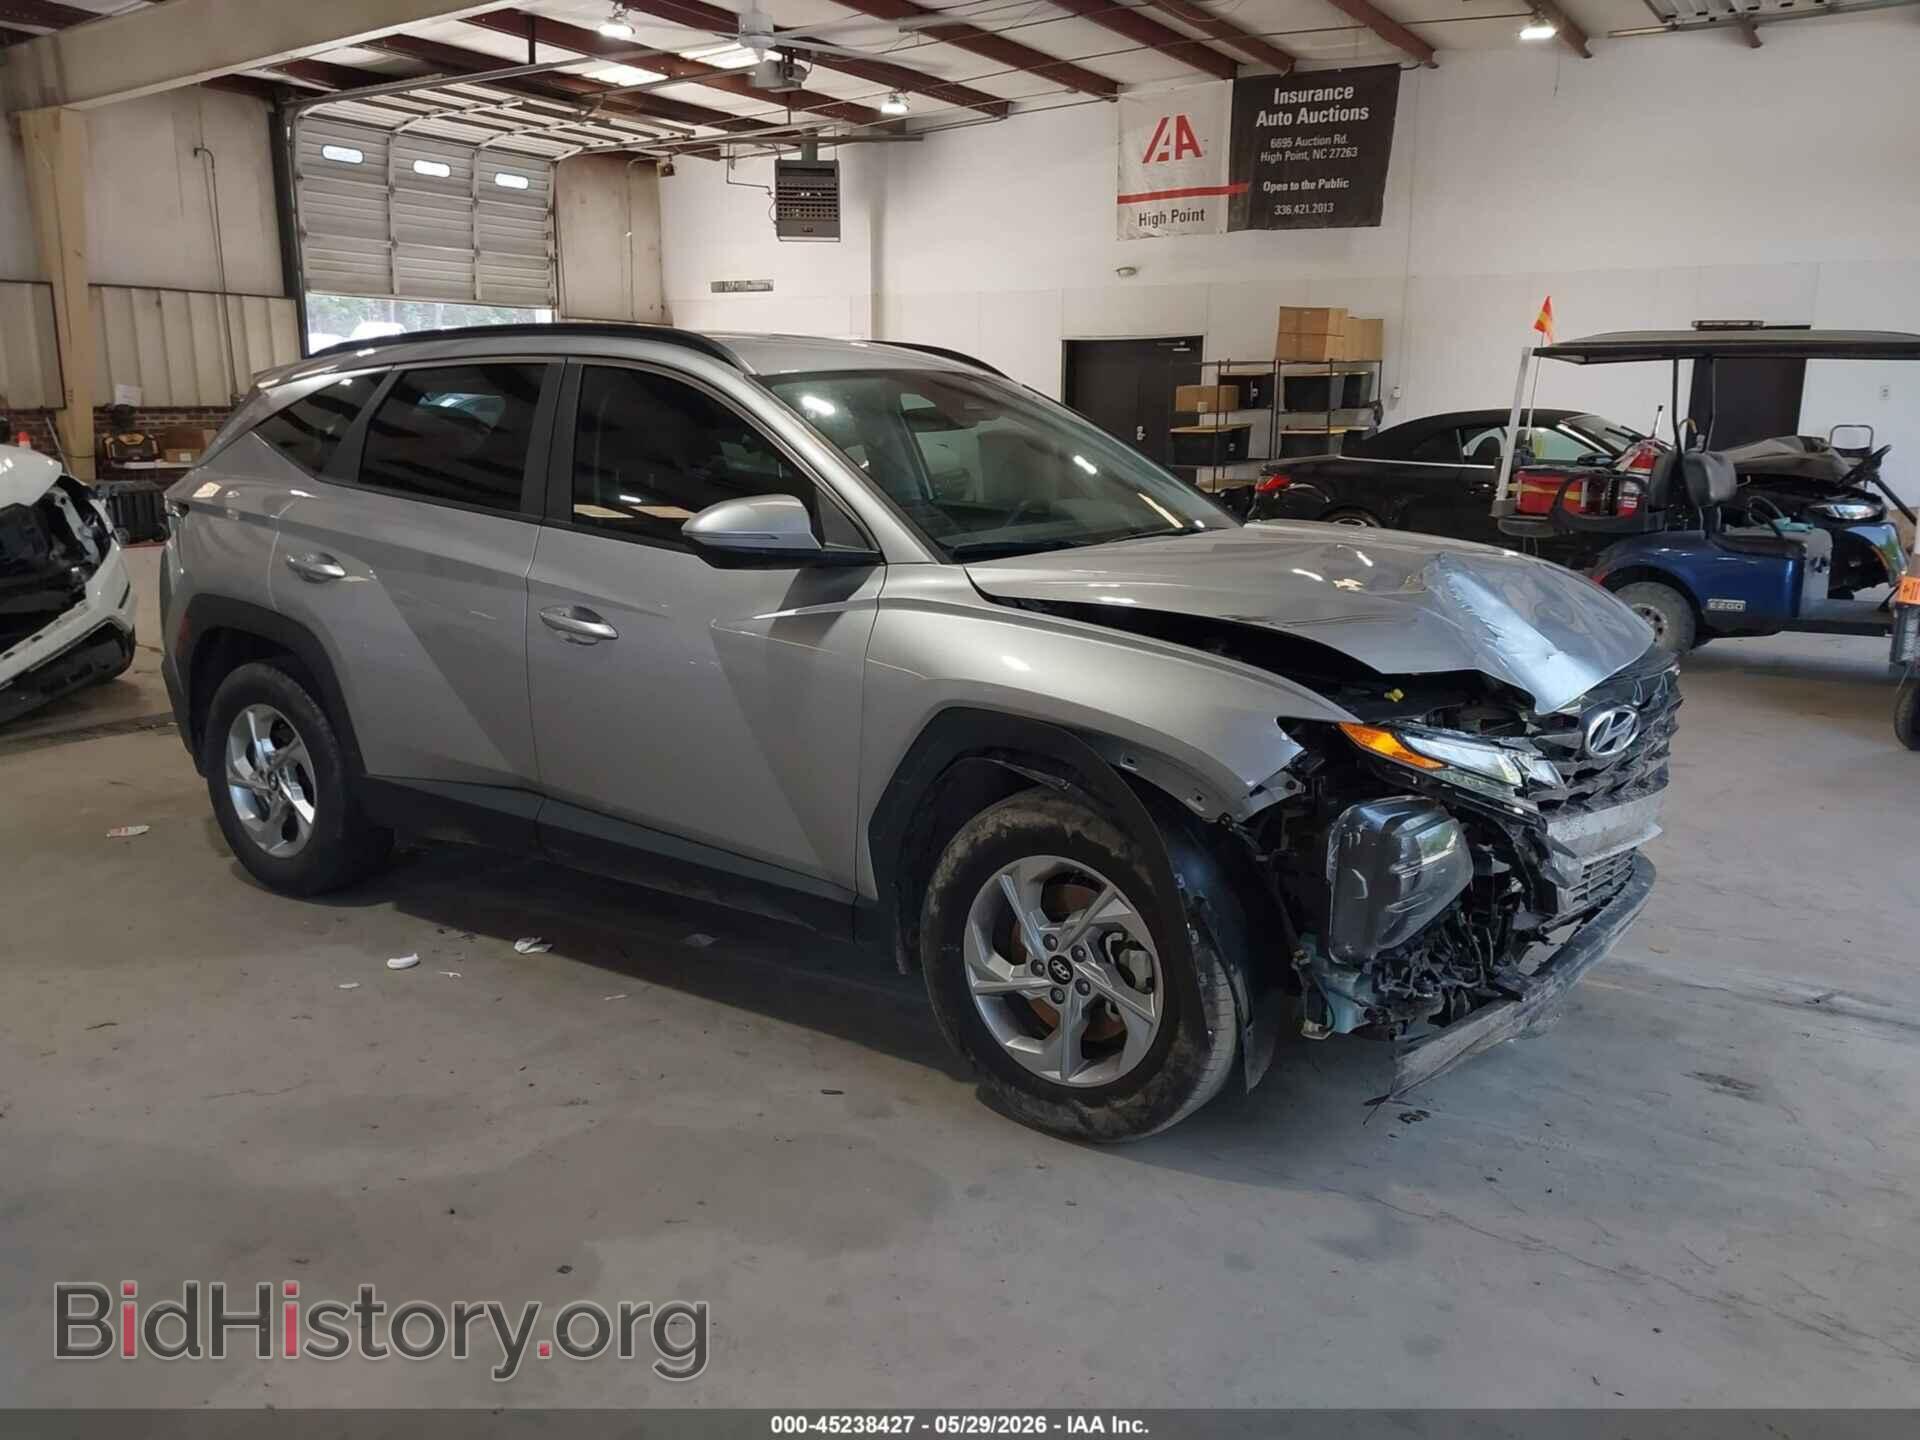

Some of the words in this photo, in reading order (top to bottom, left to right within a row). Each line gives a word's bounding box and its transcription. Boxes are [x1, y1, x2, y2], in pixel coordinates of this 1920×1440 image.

[1274, 86, 1354, 105] Insurance
[1256, 108, 1293, 128] Auto
[1296, 104, 1369, 125] Auctions
[1295, 136, 1332, 147] Auction
[1260, 151, 1283, 164] High
[1284, 149, 1310, 161] Point,
[1312, 147, 1328, 160] NC
[1329, 146, 1358, 159] 27263
[1263, 180, 1289, 194] Open
[1290, 180, 1300, 191] to
[1301, 179, 1317, 191] the
[1318, 177, 1350, 190] Public
[1138, 210, 1167, 229] High
[1170, 208, 1205, 225] Point
